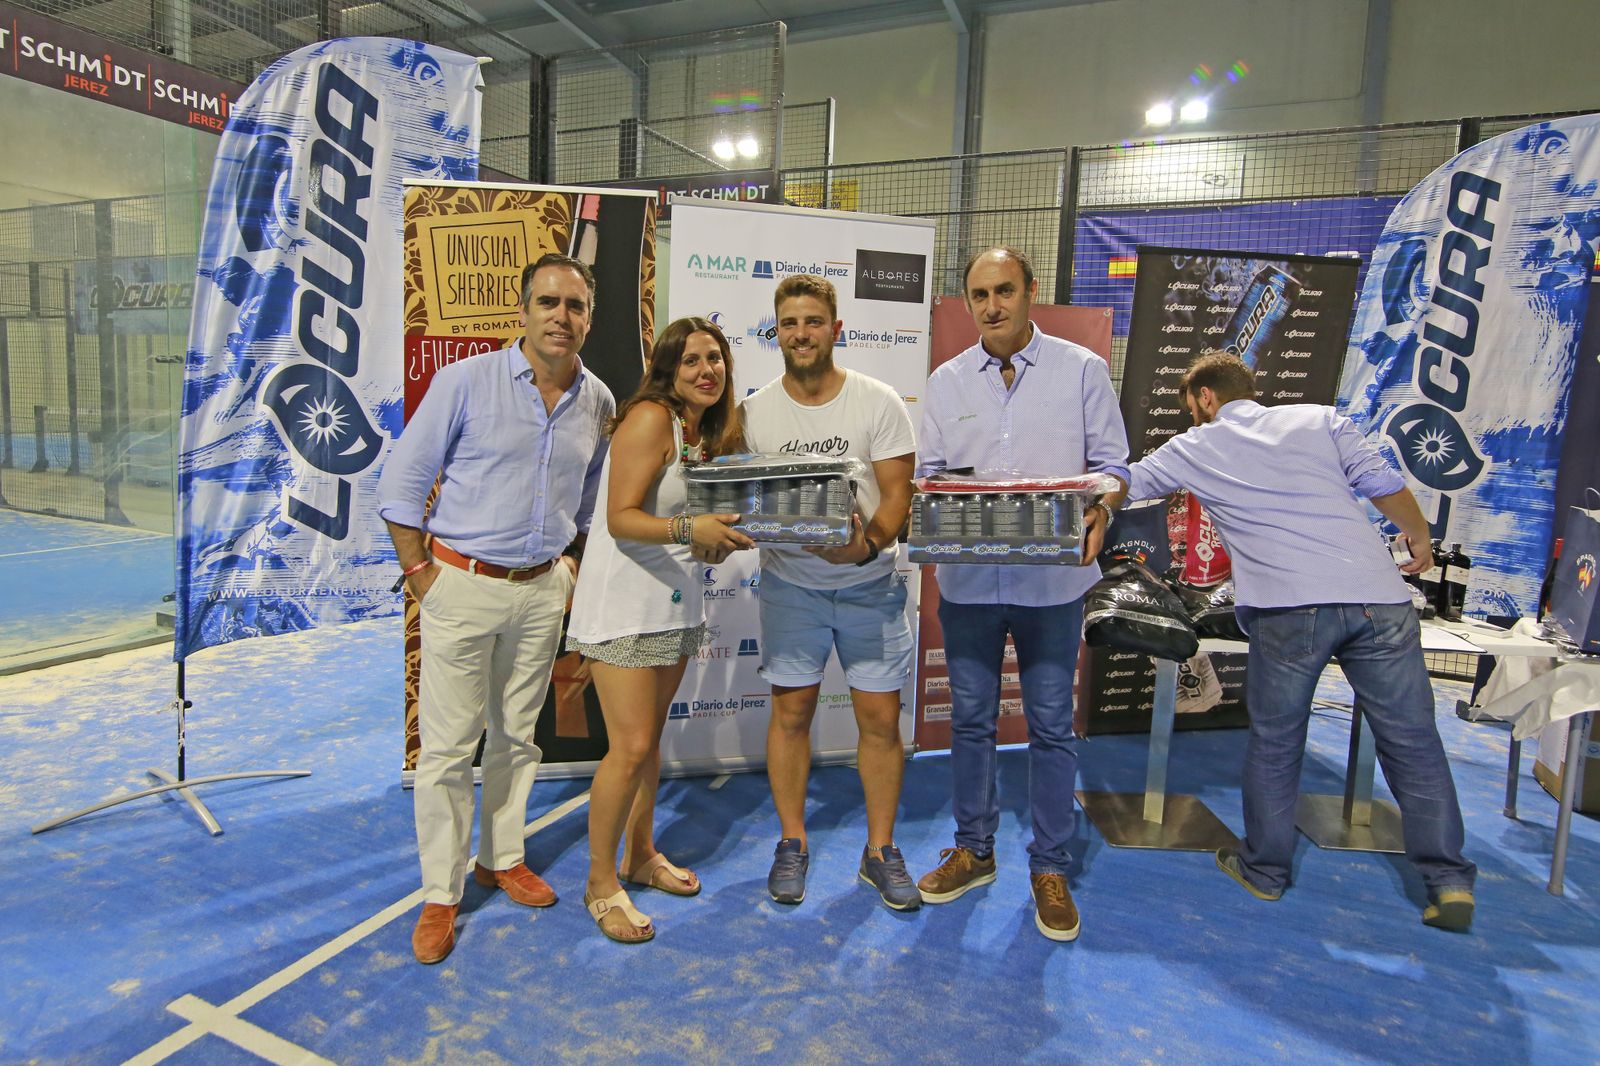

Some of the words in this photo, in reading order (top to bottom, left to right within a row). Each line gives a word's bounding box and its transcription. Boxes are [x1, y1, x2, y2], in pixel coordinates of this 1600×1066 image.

[64, 73, 109, 97] JEREZ
[188, 111, 224, 131] JEREZ
[447, 234, 520, 268] UNUSUAL
[707, 254, 747, 273] MAR
[776, 261, 806, 275] Diario
[809, 264, 822, 275] de
[824, 262, 848, 277] Jerez
[694, 272, 739, 280] RESTAURANTE
[862, 268, 919, 283] ALBORES
[1168, 281, 1200, 290] LOCURA
[446, 274, 521, 307] SHERRIES
[263, 62, 383, 540] LOCURA
[1165, 303, 1197, 312] LOCURA
[451, 324, 468, 334] BY
[1162, 324, 1194, 334] LOCURA
[1285, 329, 1315, 338] LOCURA
[849, 329, 877, 343] Diario
[879, 332, 893, 343] de
[894, 331, 917, 345] Jerez
[1159, 345, 1190, 354] LOCURA
[1281, 350, 1311, 359] LOCURA
[1155, 366, 1187, 375] LOCURA
[1277, 370, 1307, 379] LOCURA
[1273, 390, 1303, 399] LOCURA
[1149, 407, 1181, 416] LOCURA
[1146, 427, 1177, 437] LOCURA
[745, 523, 781, 532] LOCURA
[926, 544, 961, 554] LOCURA
[972, 544, 1010, 554] LOCURA
[1022, 545, 1060, 555] LOCURA
[704, 588, 736, 597] AUTIC
[694, 646, 731, 660] MATE
[927, 680, 944, 688] Diario
[692, 700, 722, 711] Diario
[725, 699, 738, 710] de
[741, 698, 765, 711] Jerez
[926, 705, 952, 714] Granada
[692, 711, 717, 719] PADEL
[720, 710, 737, 718] CUP
